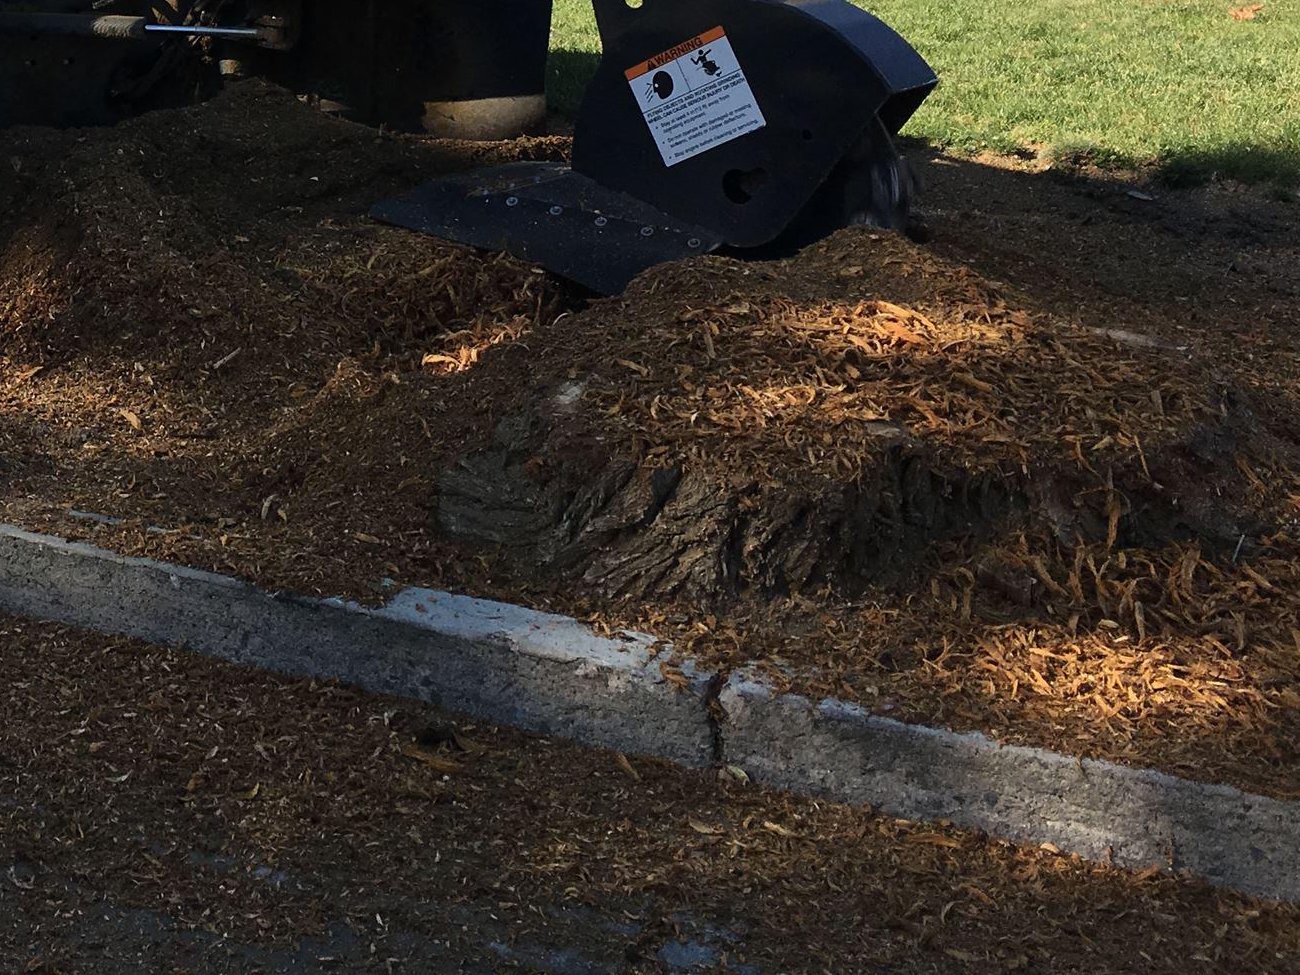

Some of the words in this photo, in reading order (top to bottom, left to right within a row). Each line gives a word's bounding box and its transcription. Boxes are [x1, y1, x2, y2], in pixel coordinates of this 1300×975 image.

[654, 36, 703, 66] WARNING
[683, 93, 694, 101] AND
[662, 109, 672, 117] CAN
[672, 103, 687, 113] CAUSE
